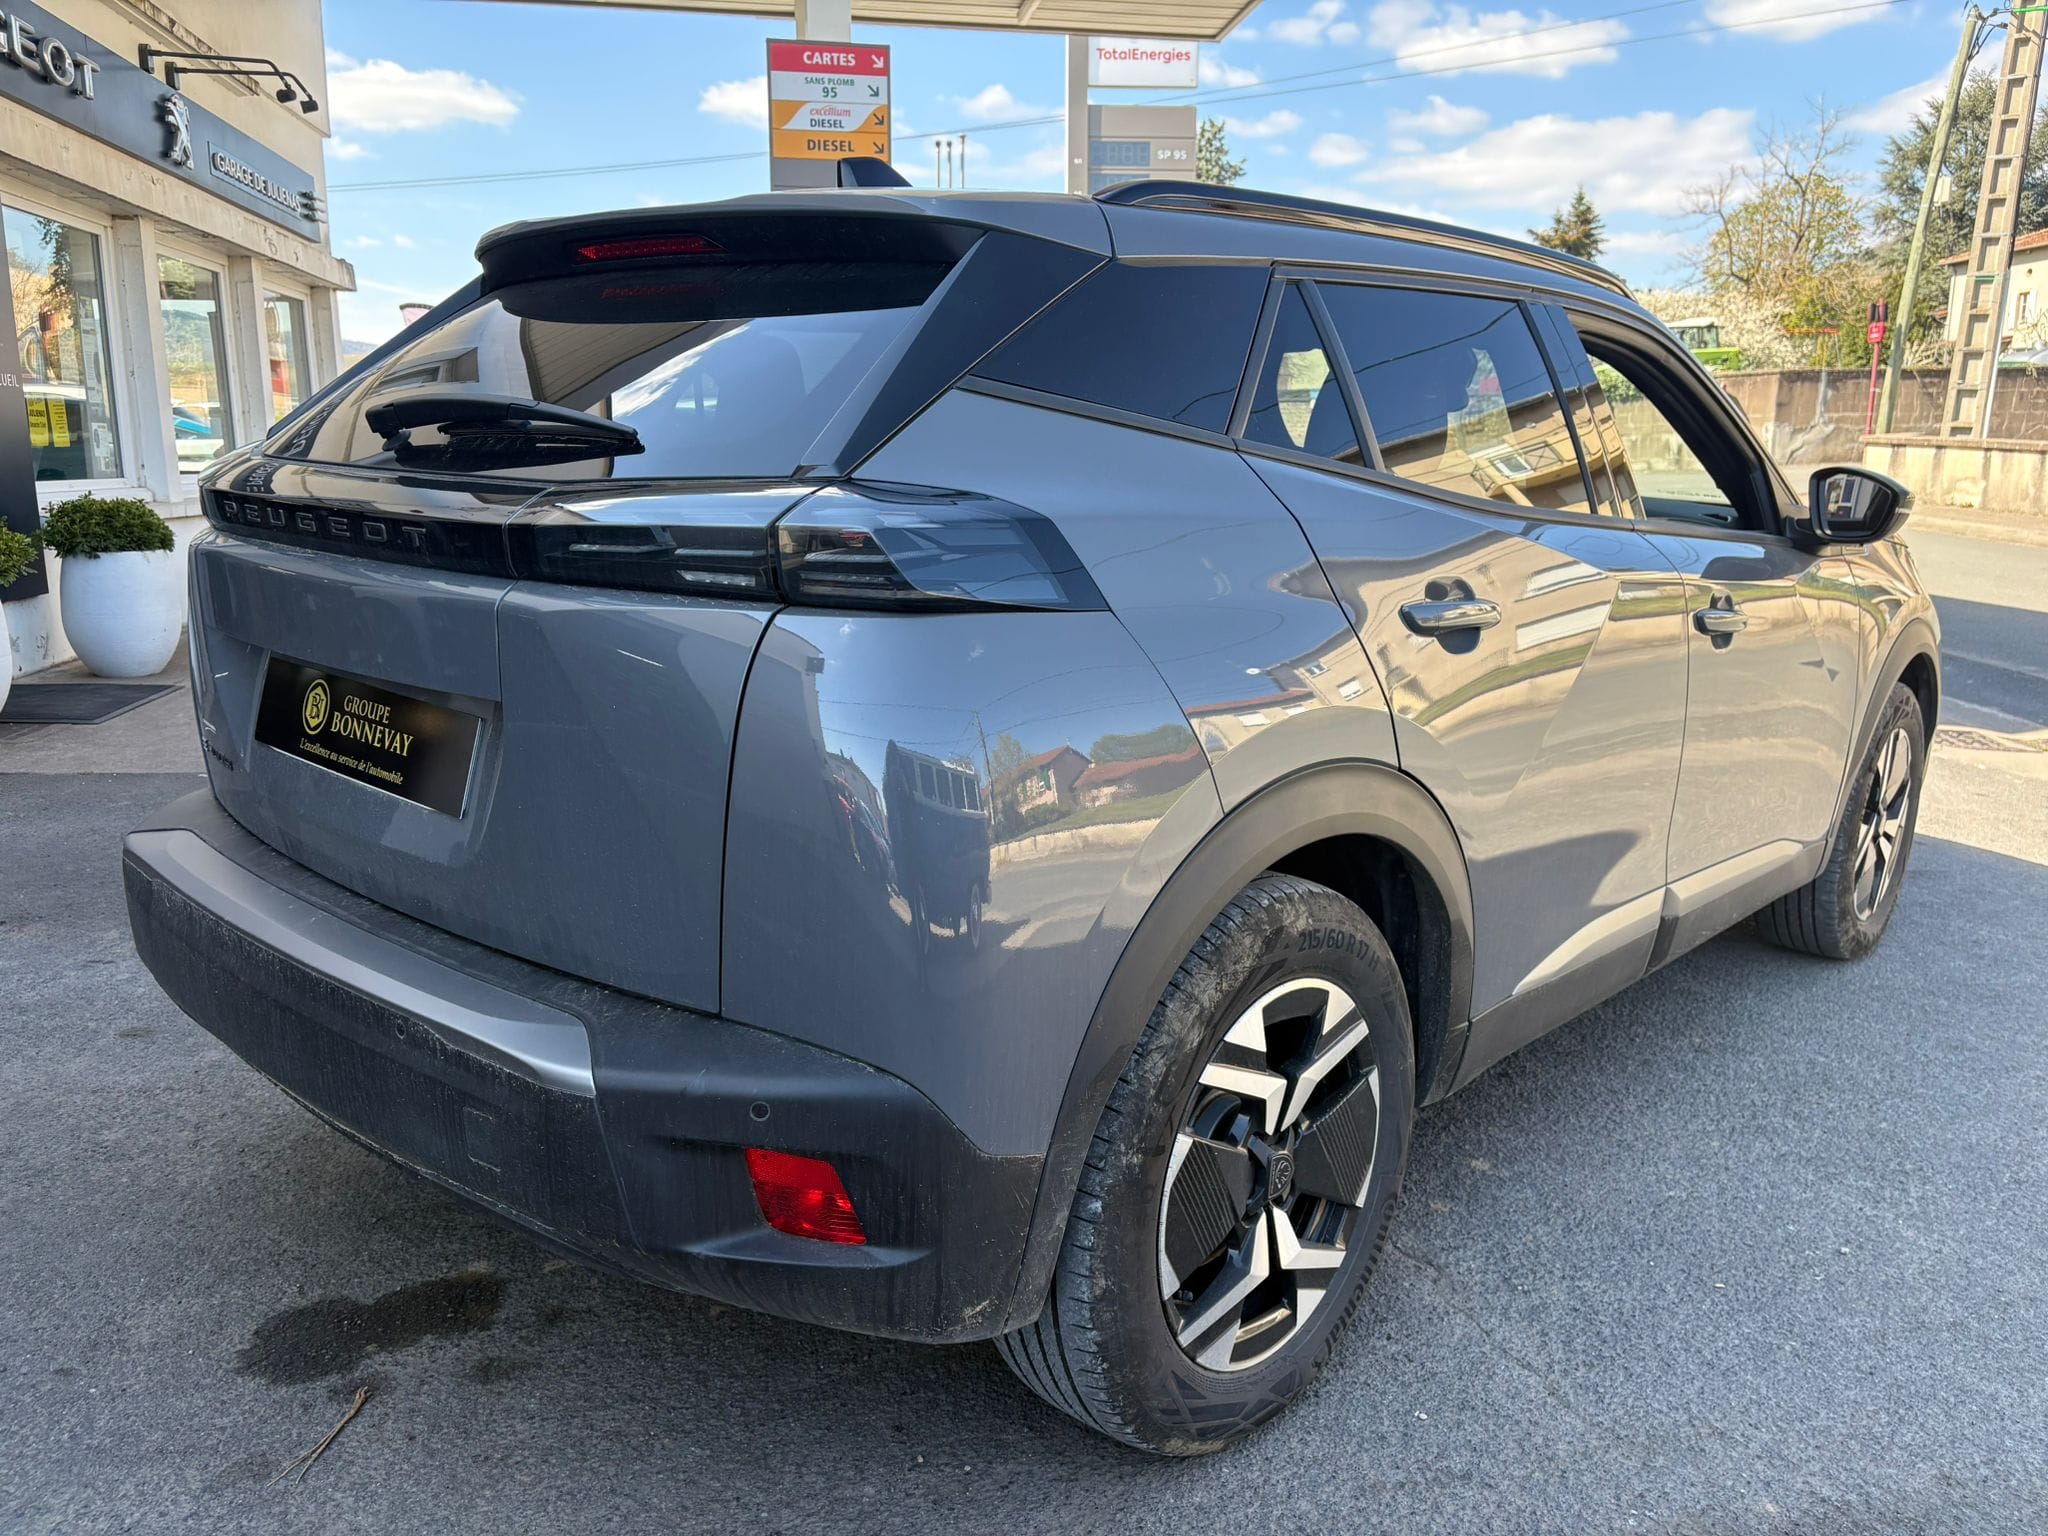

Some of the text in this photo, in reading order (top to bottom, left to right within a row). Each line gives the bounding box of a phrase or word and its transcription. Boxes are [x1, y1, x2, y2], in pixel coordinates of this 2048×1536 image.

[803, 51, 856, 67] CARTES
[1096, 47, 1192, 64] TotalEnergies
[804, 76, 855, 87] SANS PLOMB
[822, 86, 838, 98] 95
[810, 105, 851, 117] excellium
[810, 118, 845, 129] DIESEL
[807, 139, 855, 152] DIESEL
[1157, 149, 1187, 160] SP 95
[216, 152, 255, 188] GARAGE
[254, 173, 267, 194] DE
[0, 373, 20, 388] UEIL
[222, 499, 427, 548] PEUGEOT
[343, 694, 391, 724] GROUPE
[330, 711, 414, 757] BONNEVAY
[299, 737, 331, 759] L'excellence
[337, 755, 359, 770] service
[1297, 926, 1345, 953] 215/60
[1345, 933, 1357, 954] R
[1356, 939, 1371, 961] 17
